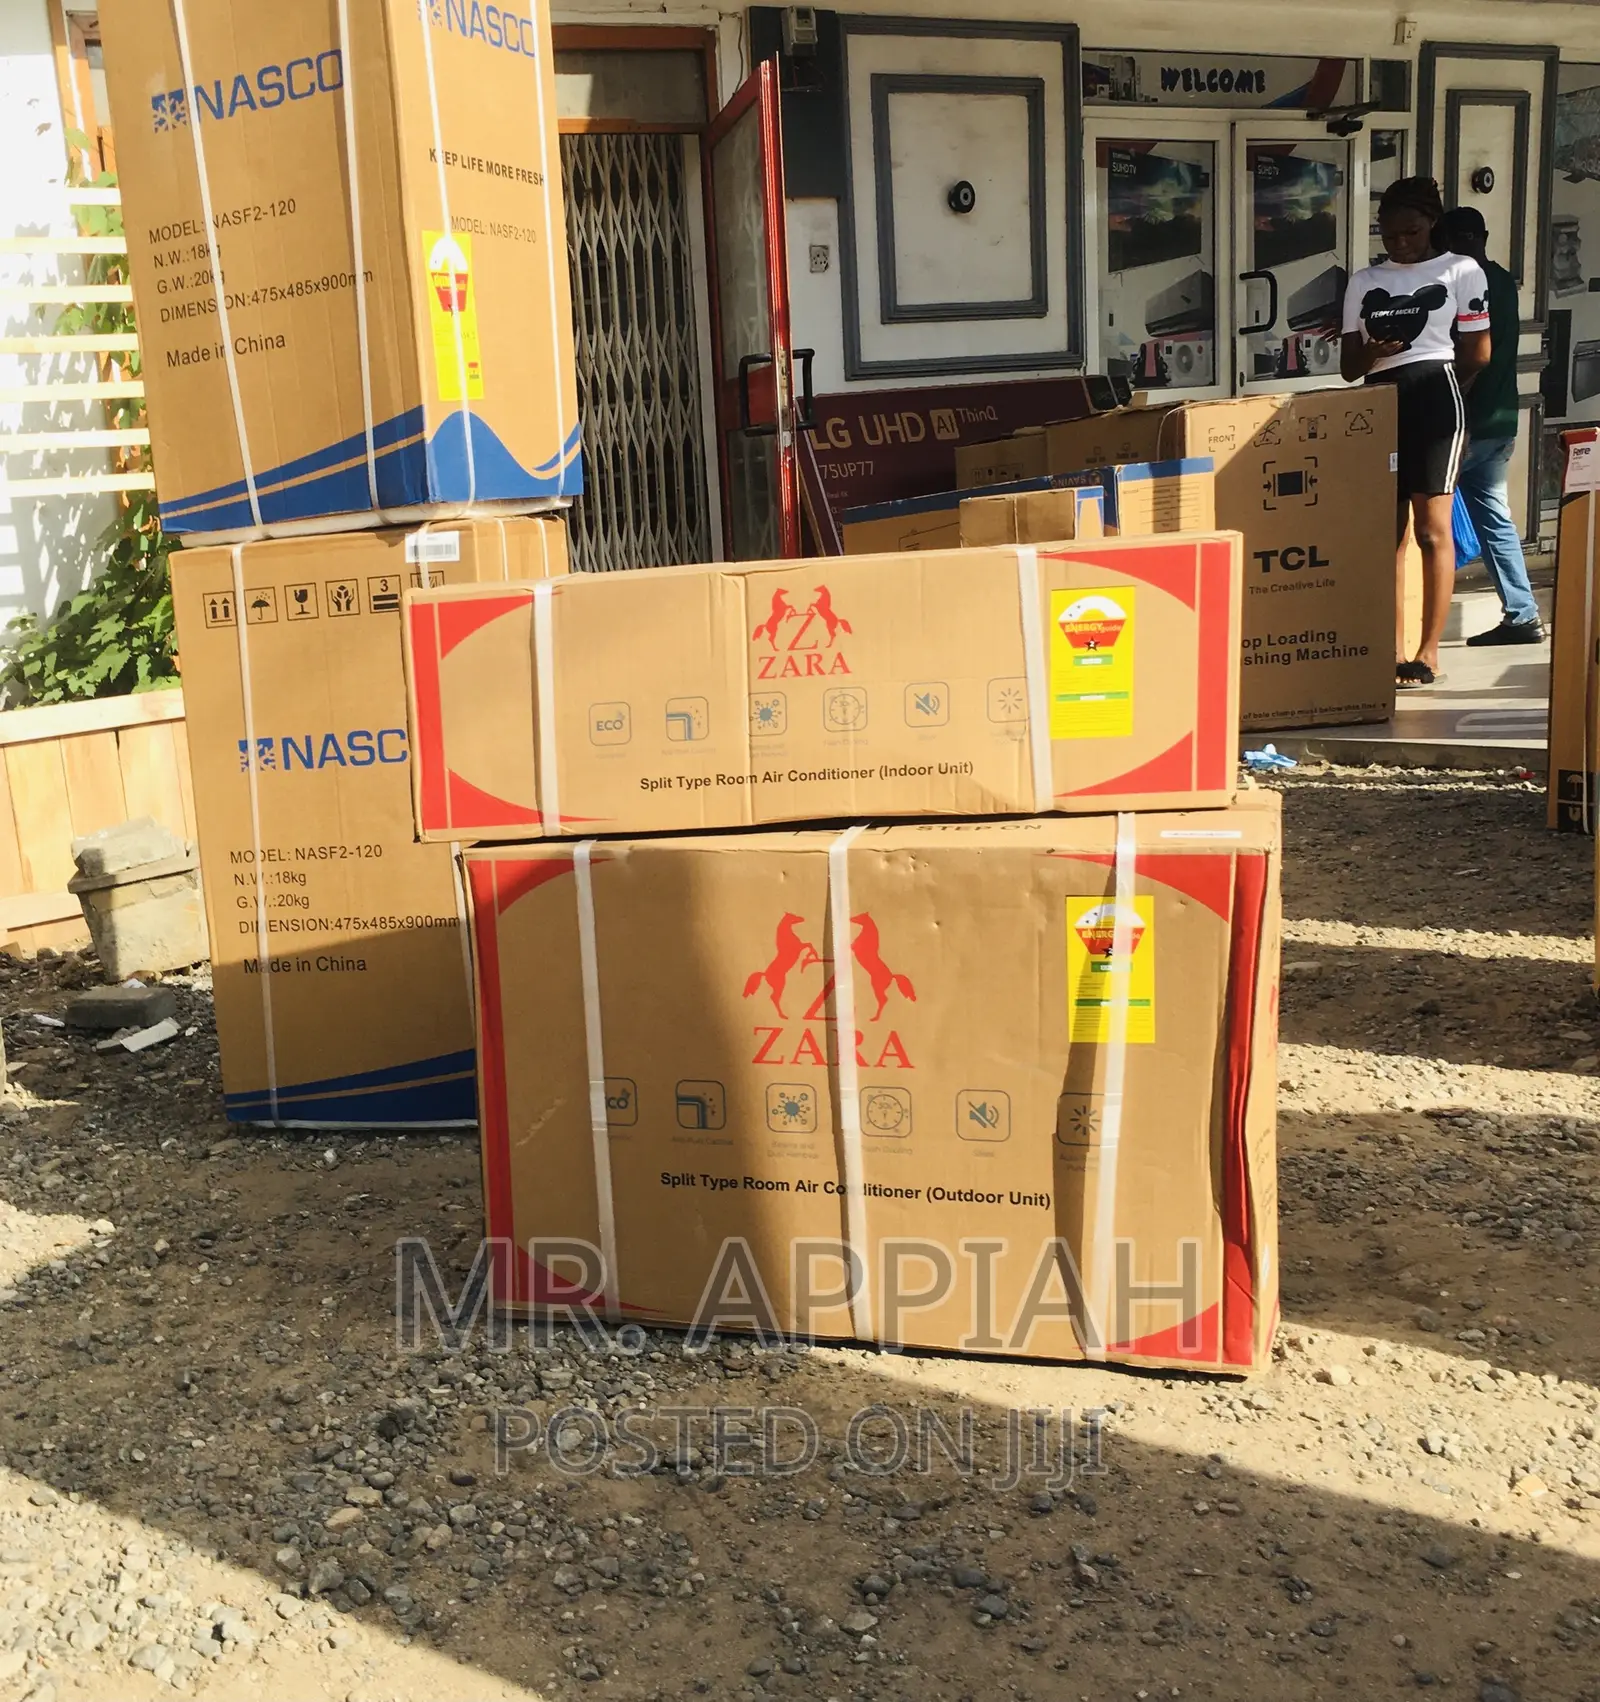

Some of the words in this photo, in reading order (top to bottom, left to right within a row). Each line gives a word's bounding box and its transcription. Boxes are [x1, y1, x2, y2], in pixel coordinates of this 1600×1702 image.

[445, 0, 536, 58] NASCO
[193, 49, 343, 121] NASCO
[1160, 67, 1266, 94] WELCOME
[429, 148, 458, 167] KEP
[461, 154, 484, 173] LIFE
[486, 160, 514, 179] MORE
[451, 215, 487, 235] MODEL:
[489, 222, 537, 244] NASF2-120
[160, 269, 374, 323] DIMENSON:475x485x900mm
[1370, 309, 1395, 319] PEOPLE
[167, 346, 211, 368] Made
[234, 333, 286, 356] China
[808, 416, 852, 451] LG
[858, 412, 926, 446] UHD
[937, 413, 957, 434] AI
[956, 405, 999, 424] ThinQ
[1208, 434, 1235, 444] FRONT
[818, 460, 875, 480] 75UP77
[1253, 545, 1330, 573] TCL
[380, 579, 389, 592] 3
[1249, 586, 1269, 595] The
[1270, 581, 1314, 593] Creative
[1316, 578, 1336, 588] Life
[1064, 623, 1103, 633] ENERGY
[1241, 637, 1262, 650] op
[1267, 630, 1337, 647] Loading
[757, 652, 853, 680] ZARA
[1243, 651, 1291, 666] shing
[1296, 645, 1369, 661] Machine
[596, 720, 623, 732] ECO
[281, 729, 408, 770] NASC
[640, 777, 672, 792] Split
[676, 776, 712, 792] Type
[716, 773, 758, 787] Room
[762, 771, 783, 784] Air
[787, 767, 875, 783] Conditioner
[879, 764, 934, 780] (Indoor
[938, 761, 974, 776] Unit)
[295, 844, 383, 861] NASF2-120
[239, 915, 461, 934] DIENSION:475x485x900mm
[296, 957, 311, 972] in
[316, 956, 367, 972] China
[752, 1027, 916, 1069] ZARA
[604, 1096, 629, 1110] CO
[661, 1172, 696, 1188] Split
[701, 1174, 738, 1191] Type
[743, 1176, 790, 1192] Room
[795, 1178, 819, 1193] Air
[823, 1181, 922, 1199] Coitioner
[926, 1186, 1004, 1204] (Outdoor
[1009, 1191, 1052, 1209] Unit)
